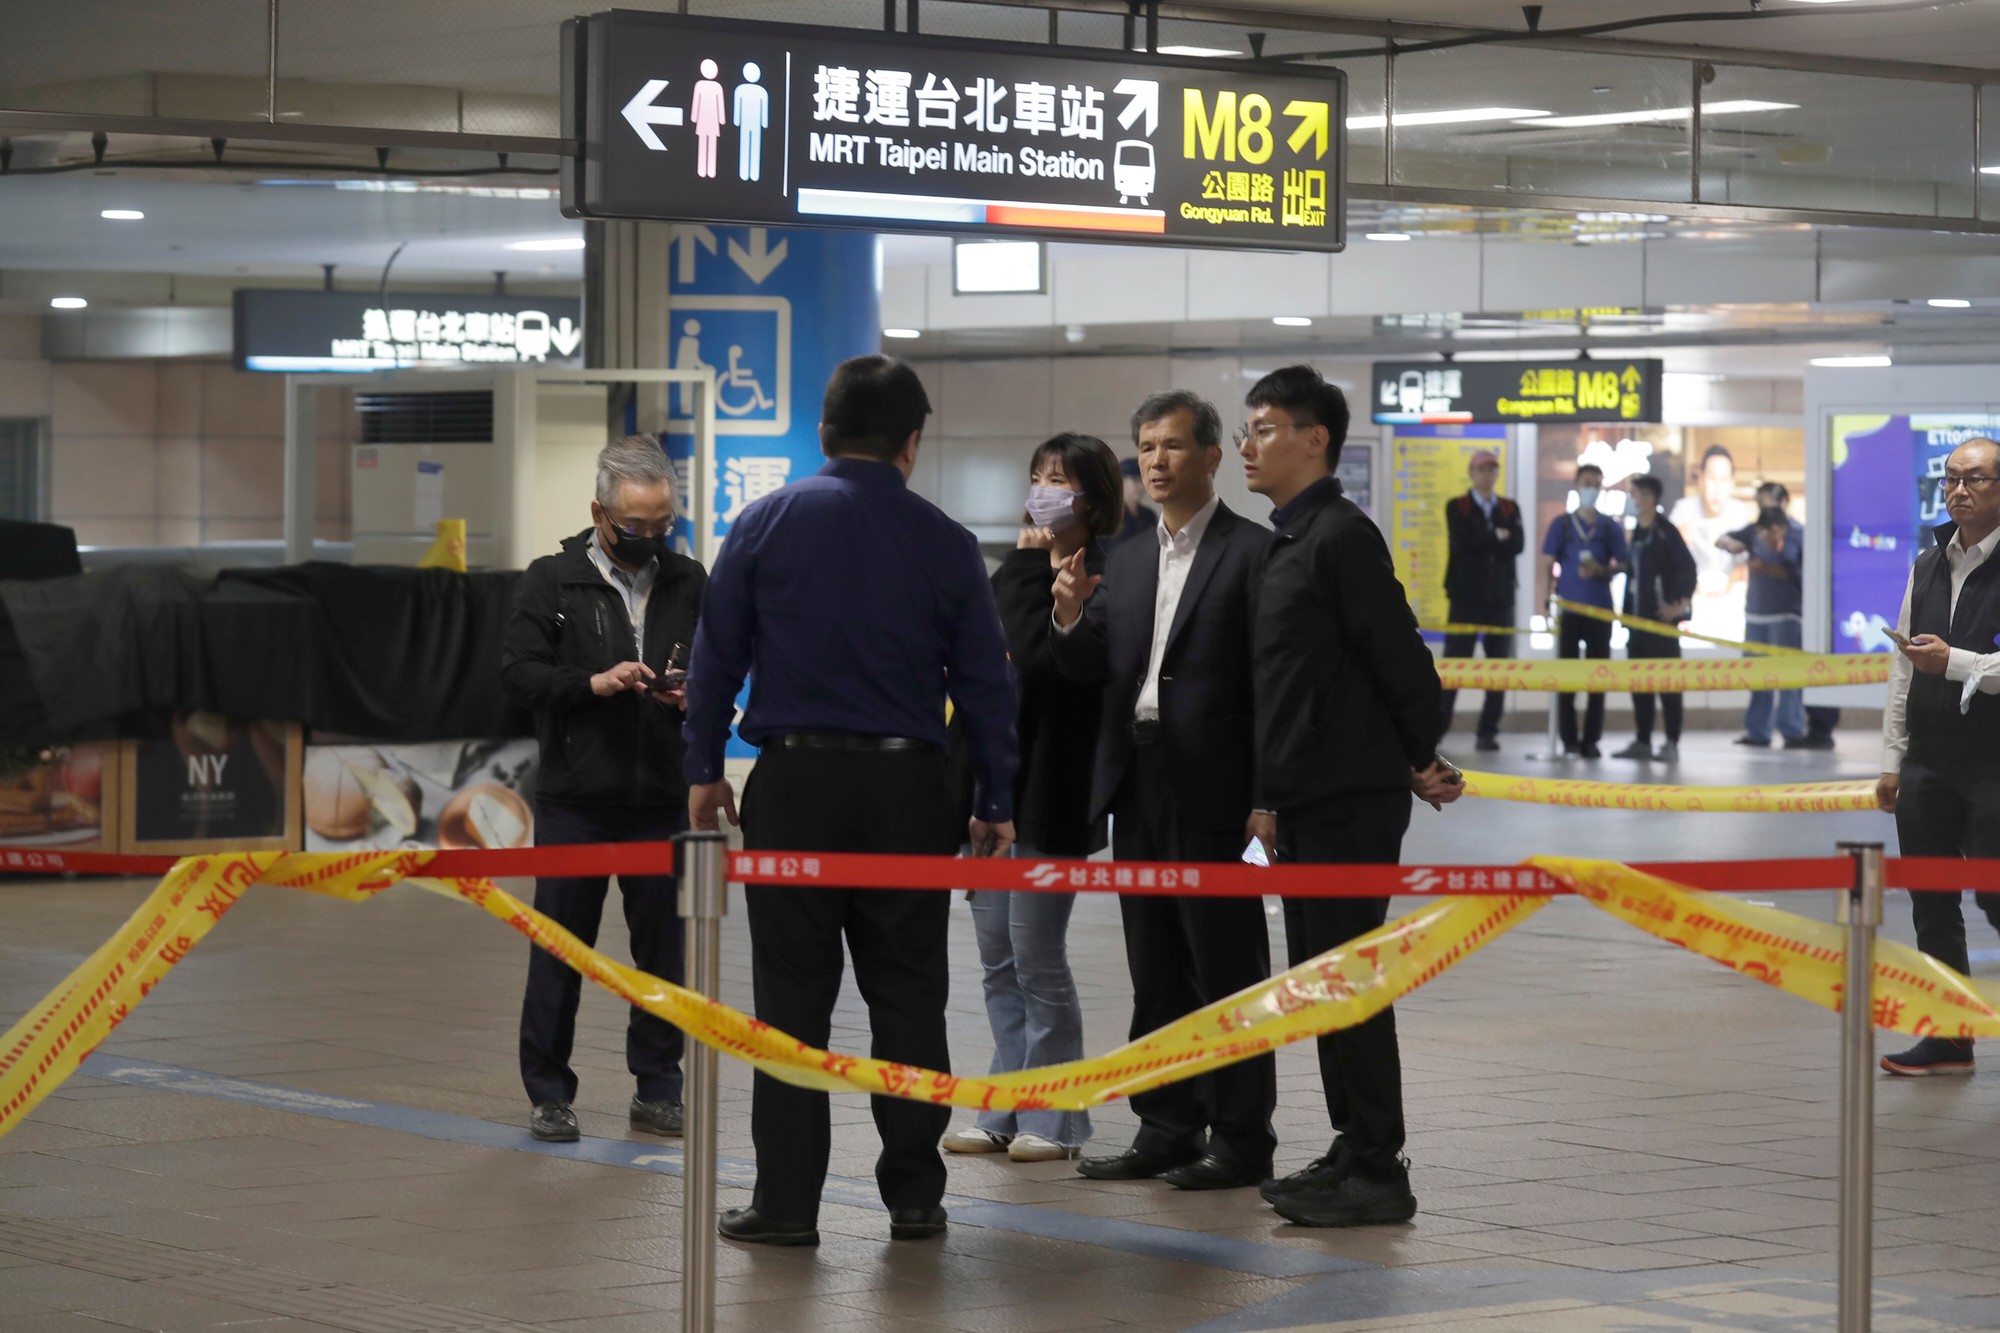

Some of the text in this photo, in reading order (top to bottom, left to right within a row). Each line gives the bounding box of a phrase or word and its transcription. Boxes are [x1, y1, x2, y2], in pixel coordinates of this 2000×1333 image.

[813, 64, 1105, 141] 捷運台北車站
[1183, 87, 1274, 165] M8
[809, 132, 1105, 180] MRT Taipei Main Station
[1202, 170, 1275, 203] 公園路
[1282, 167, 1326, 226] 出口
[1180, 202, 1275, 224] Gongyuan Rd.
[1304, 210, 1327, 226] EXIT
[1578, 371, 1620, 410] M8
[187, 753, 229, 787] NY
